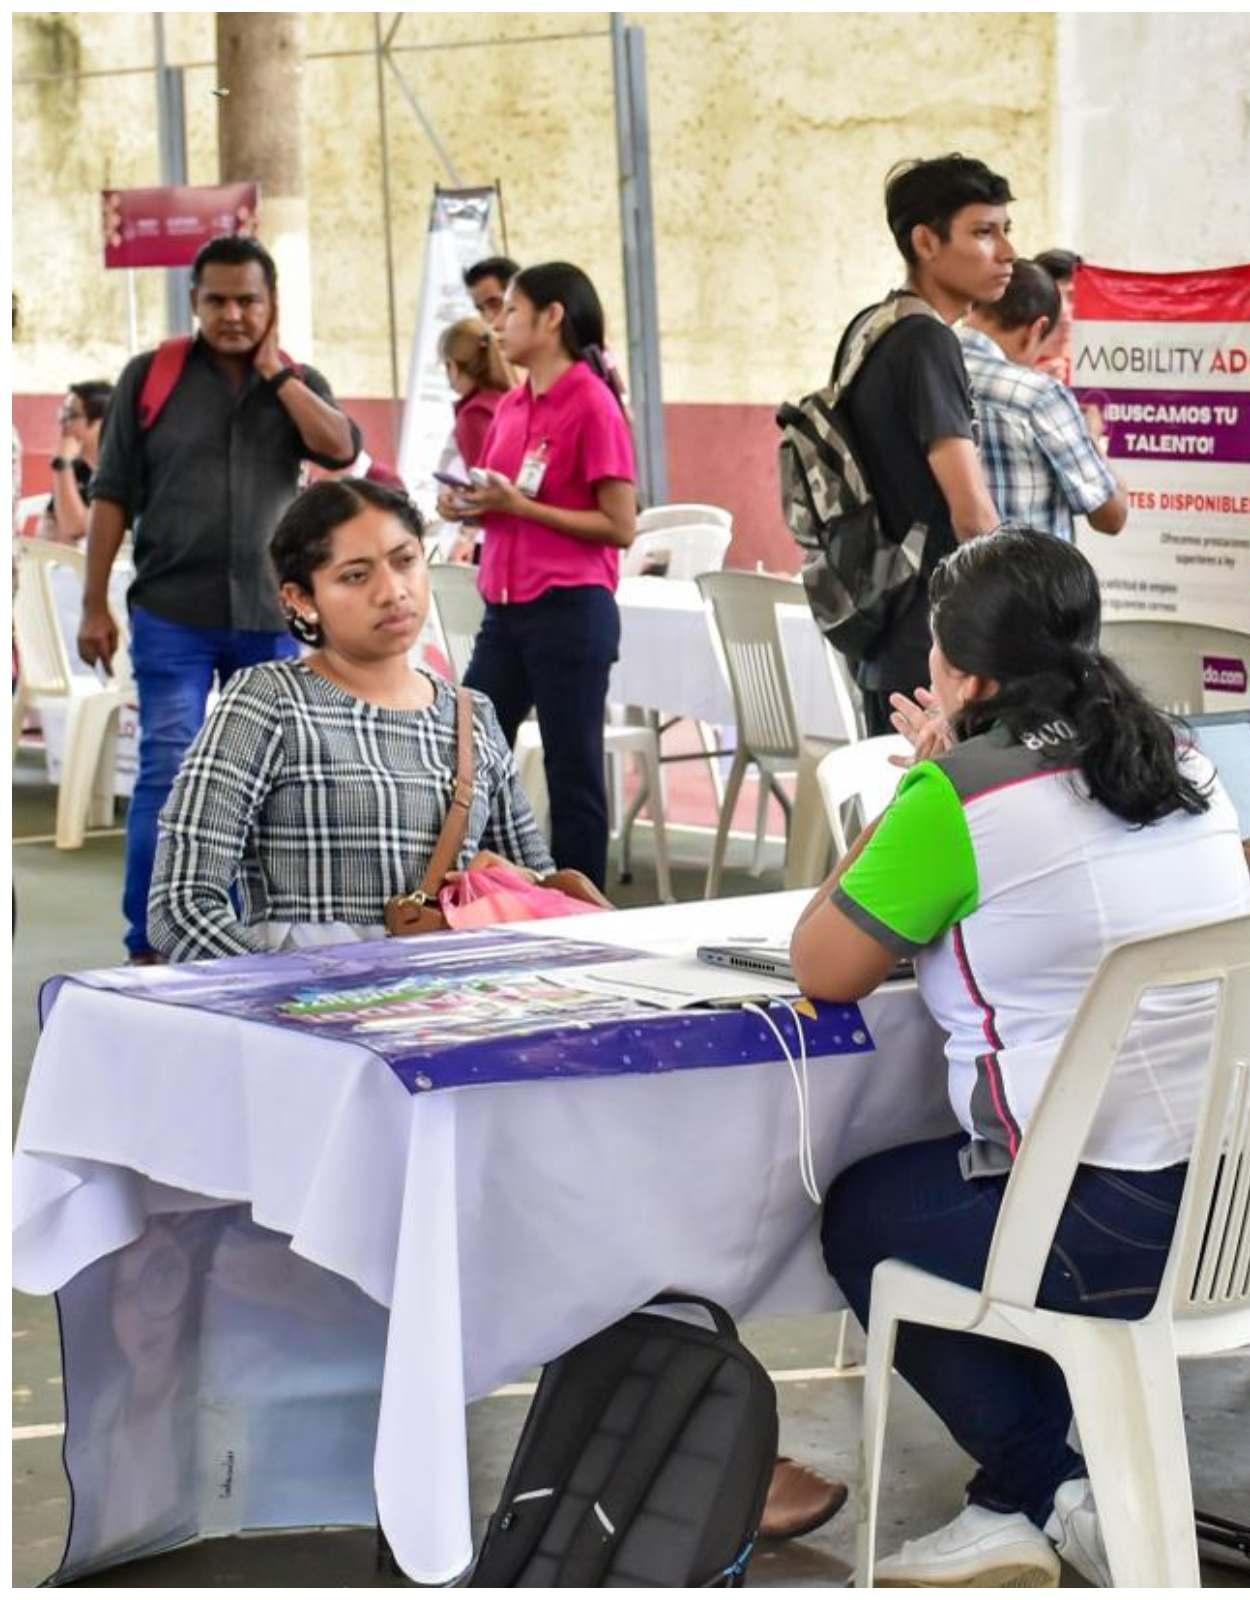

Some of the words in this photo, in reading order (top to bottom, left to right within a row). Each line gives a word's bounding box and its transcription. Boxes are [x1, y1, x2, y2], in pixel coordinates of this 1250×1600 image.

[1077, 345, 1203, 373] MOBILITY
[1213, 406, 1237, 424] TU
[1124, 434, 1214, 454] TALENTO!
